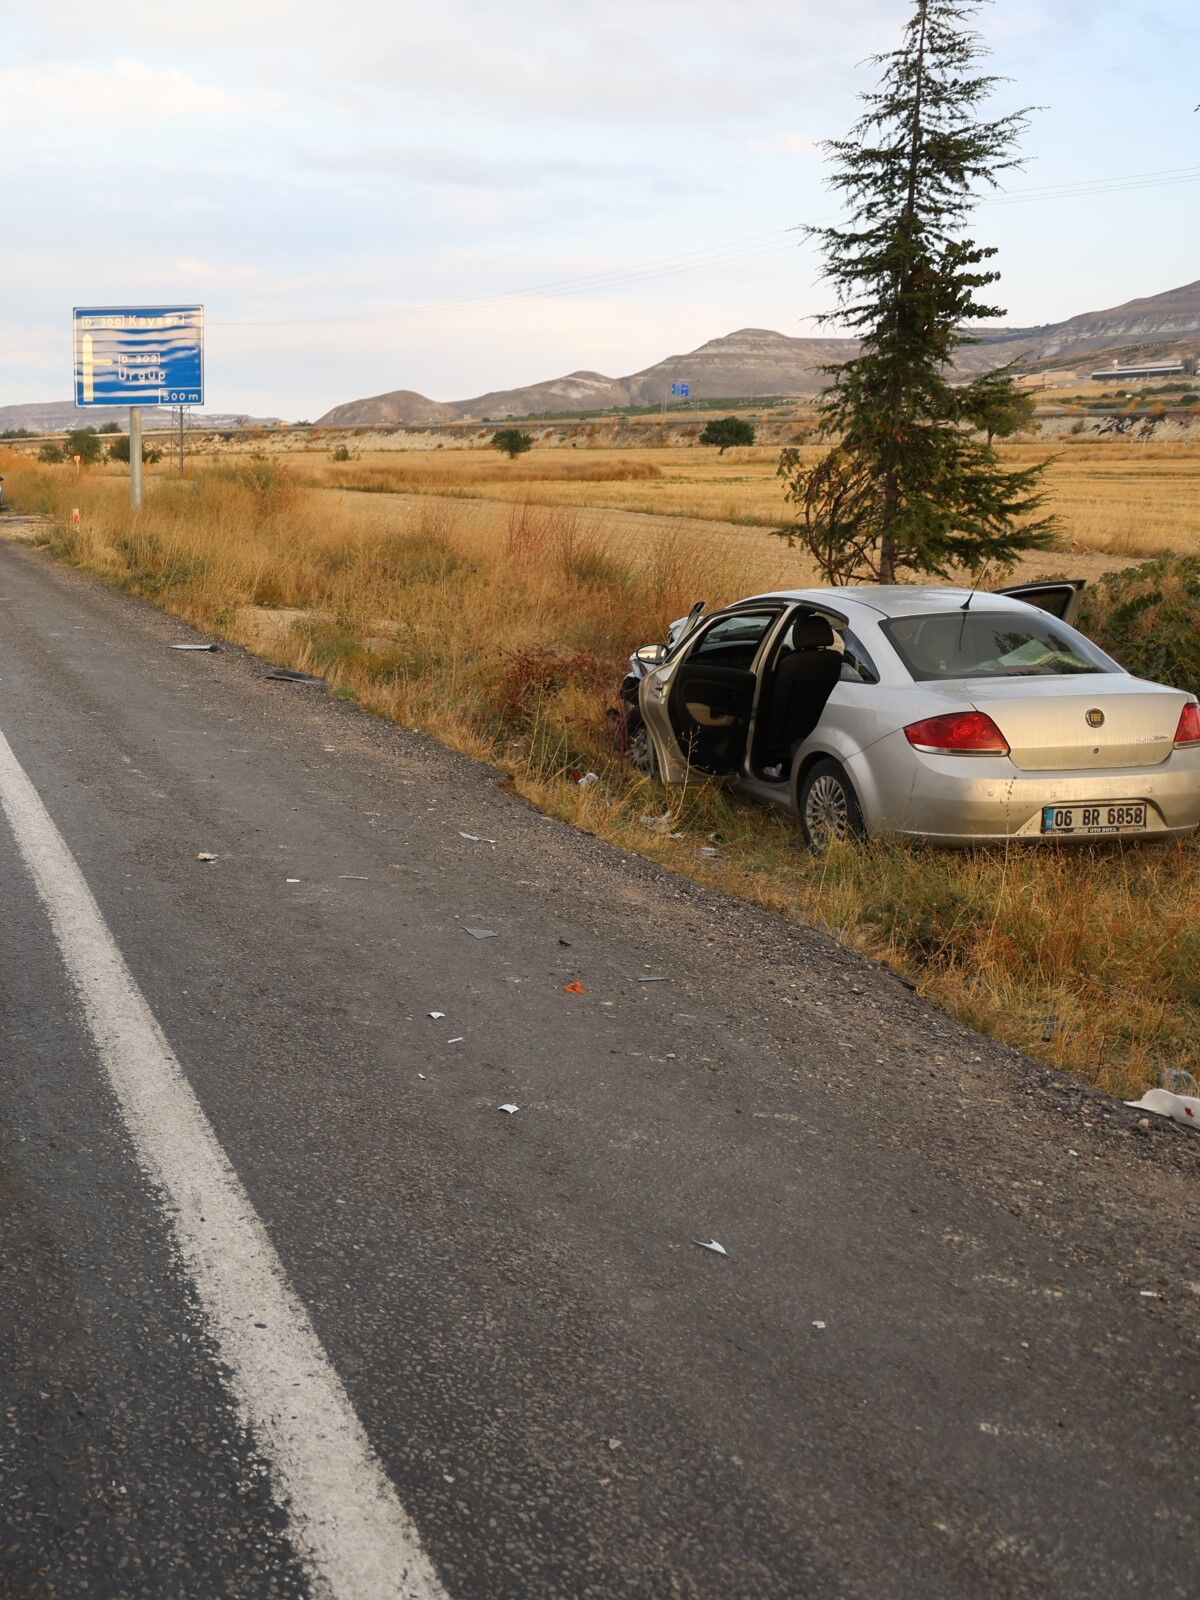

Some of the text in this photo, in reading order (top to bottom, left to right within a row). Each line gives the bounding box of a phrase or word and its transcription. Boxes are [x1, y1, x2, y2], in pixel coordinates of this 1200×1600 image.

[163, 393, 186, 401] 500
[1055, 807, 1143, 827] 06 BR 6858
